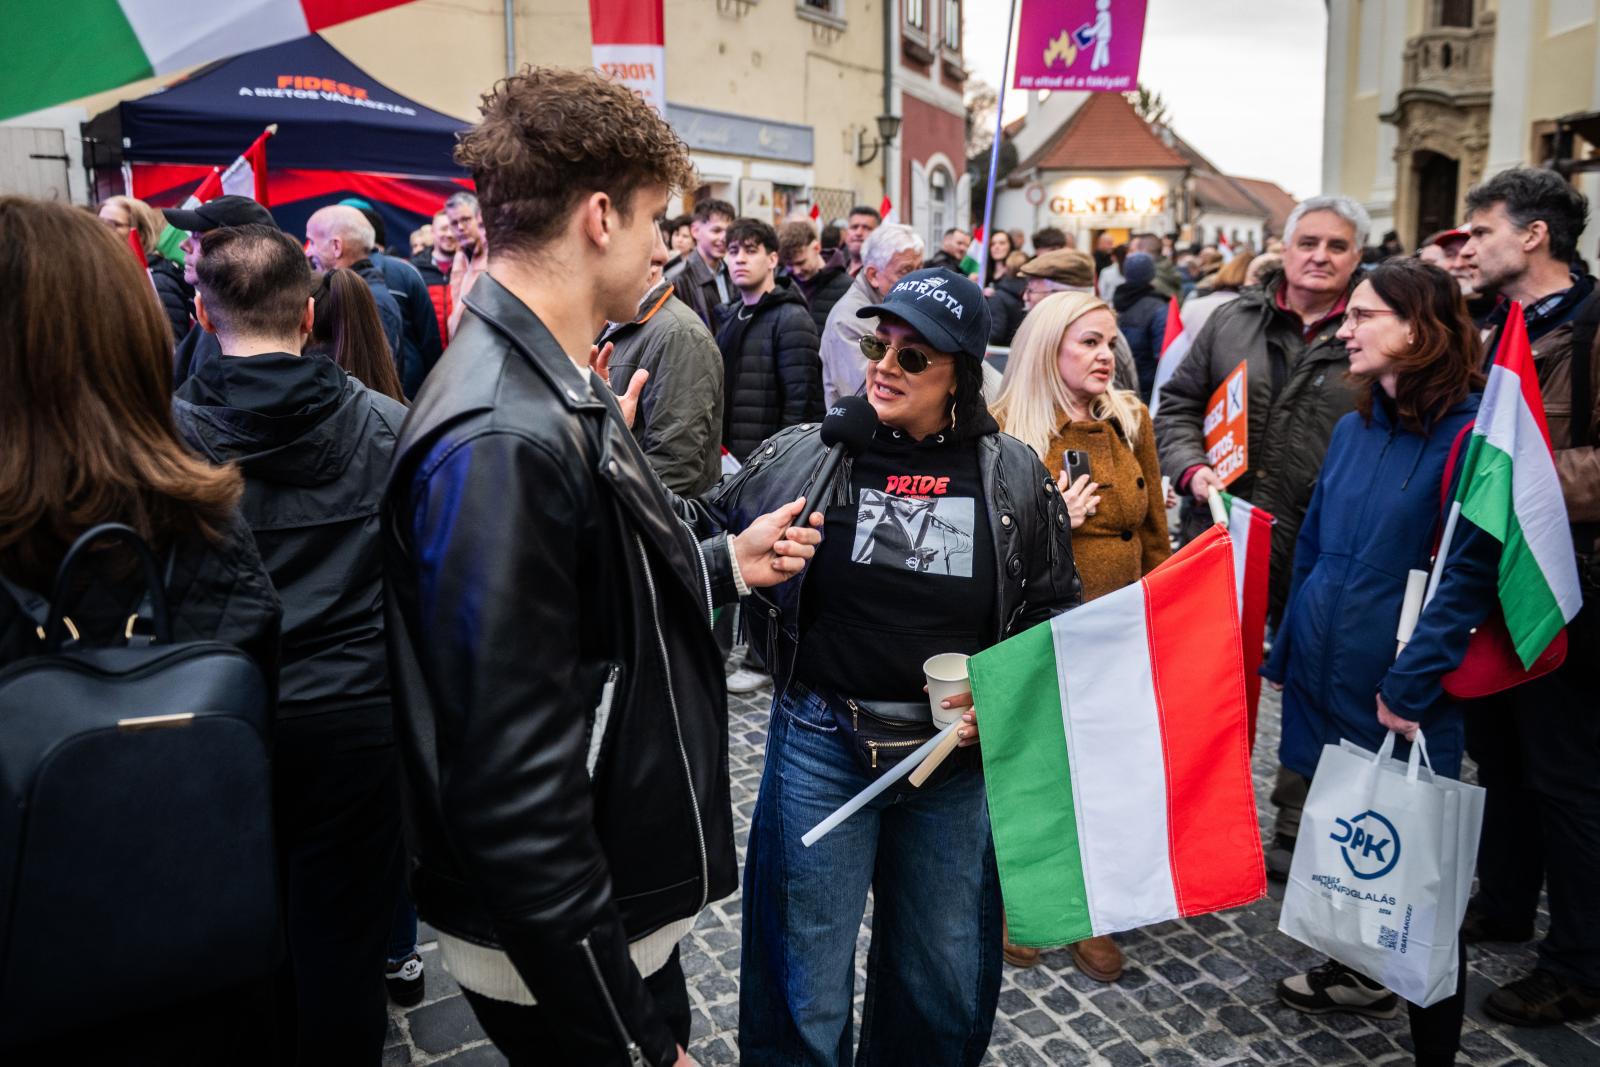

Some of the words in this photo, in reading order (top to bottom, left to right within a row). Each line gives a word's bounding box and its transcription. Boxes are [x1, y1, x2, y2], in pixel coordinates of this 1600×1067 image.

[277, 75, 368, 100] FIDESZ
[1076, 78, 1084, 87] a
[239, 87, 253, 96] A
[254, 88, 319, 99] BIZTOS
[884, 475, 951, 495] PRIDE
